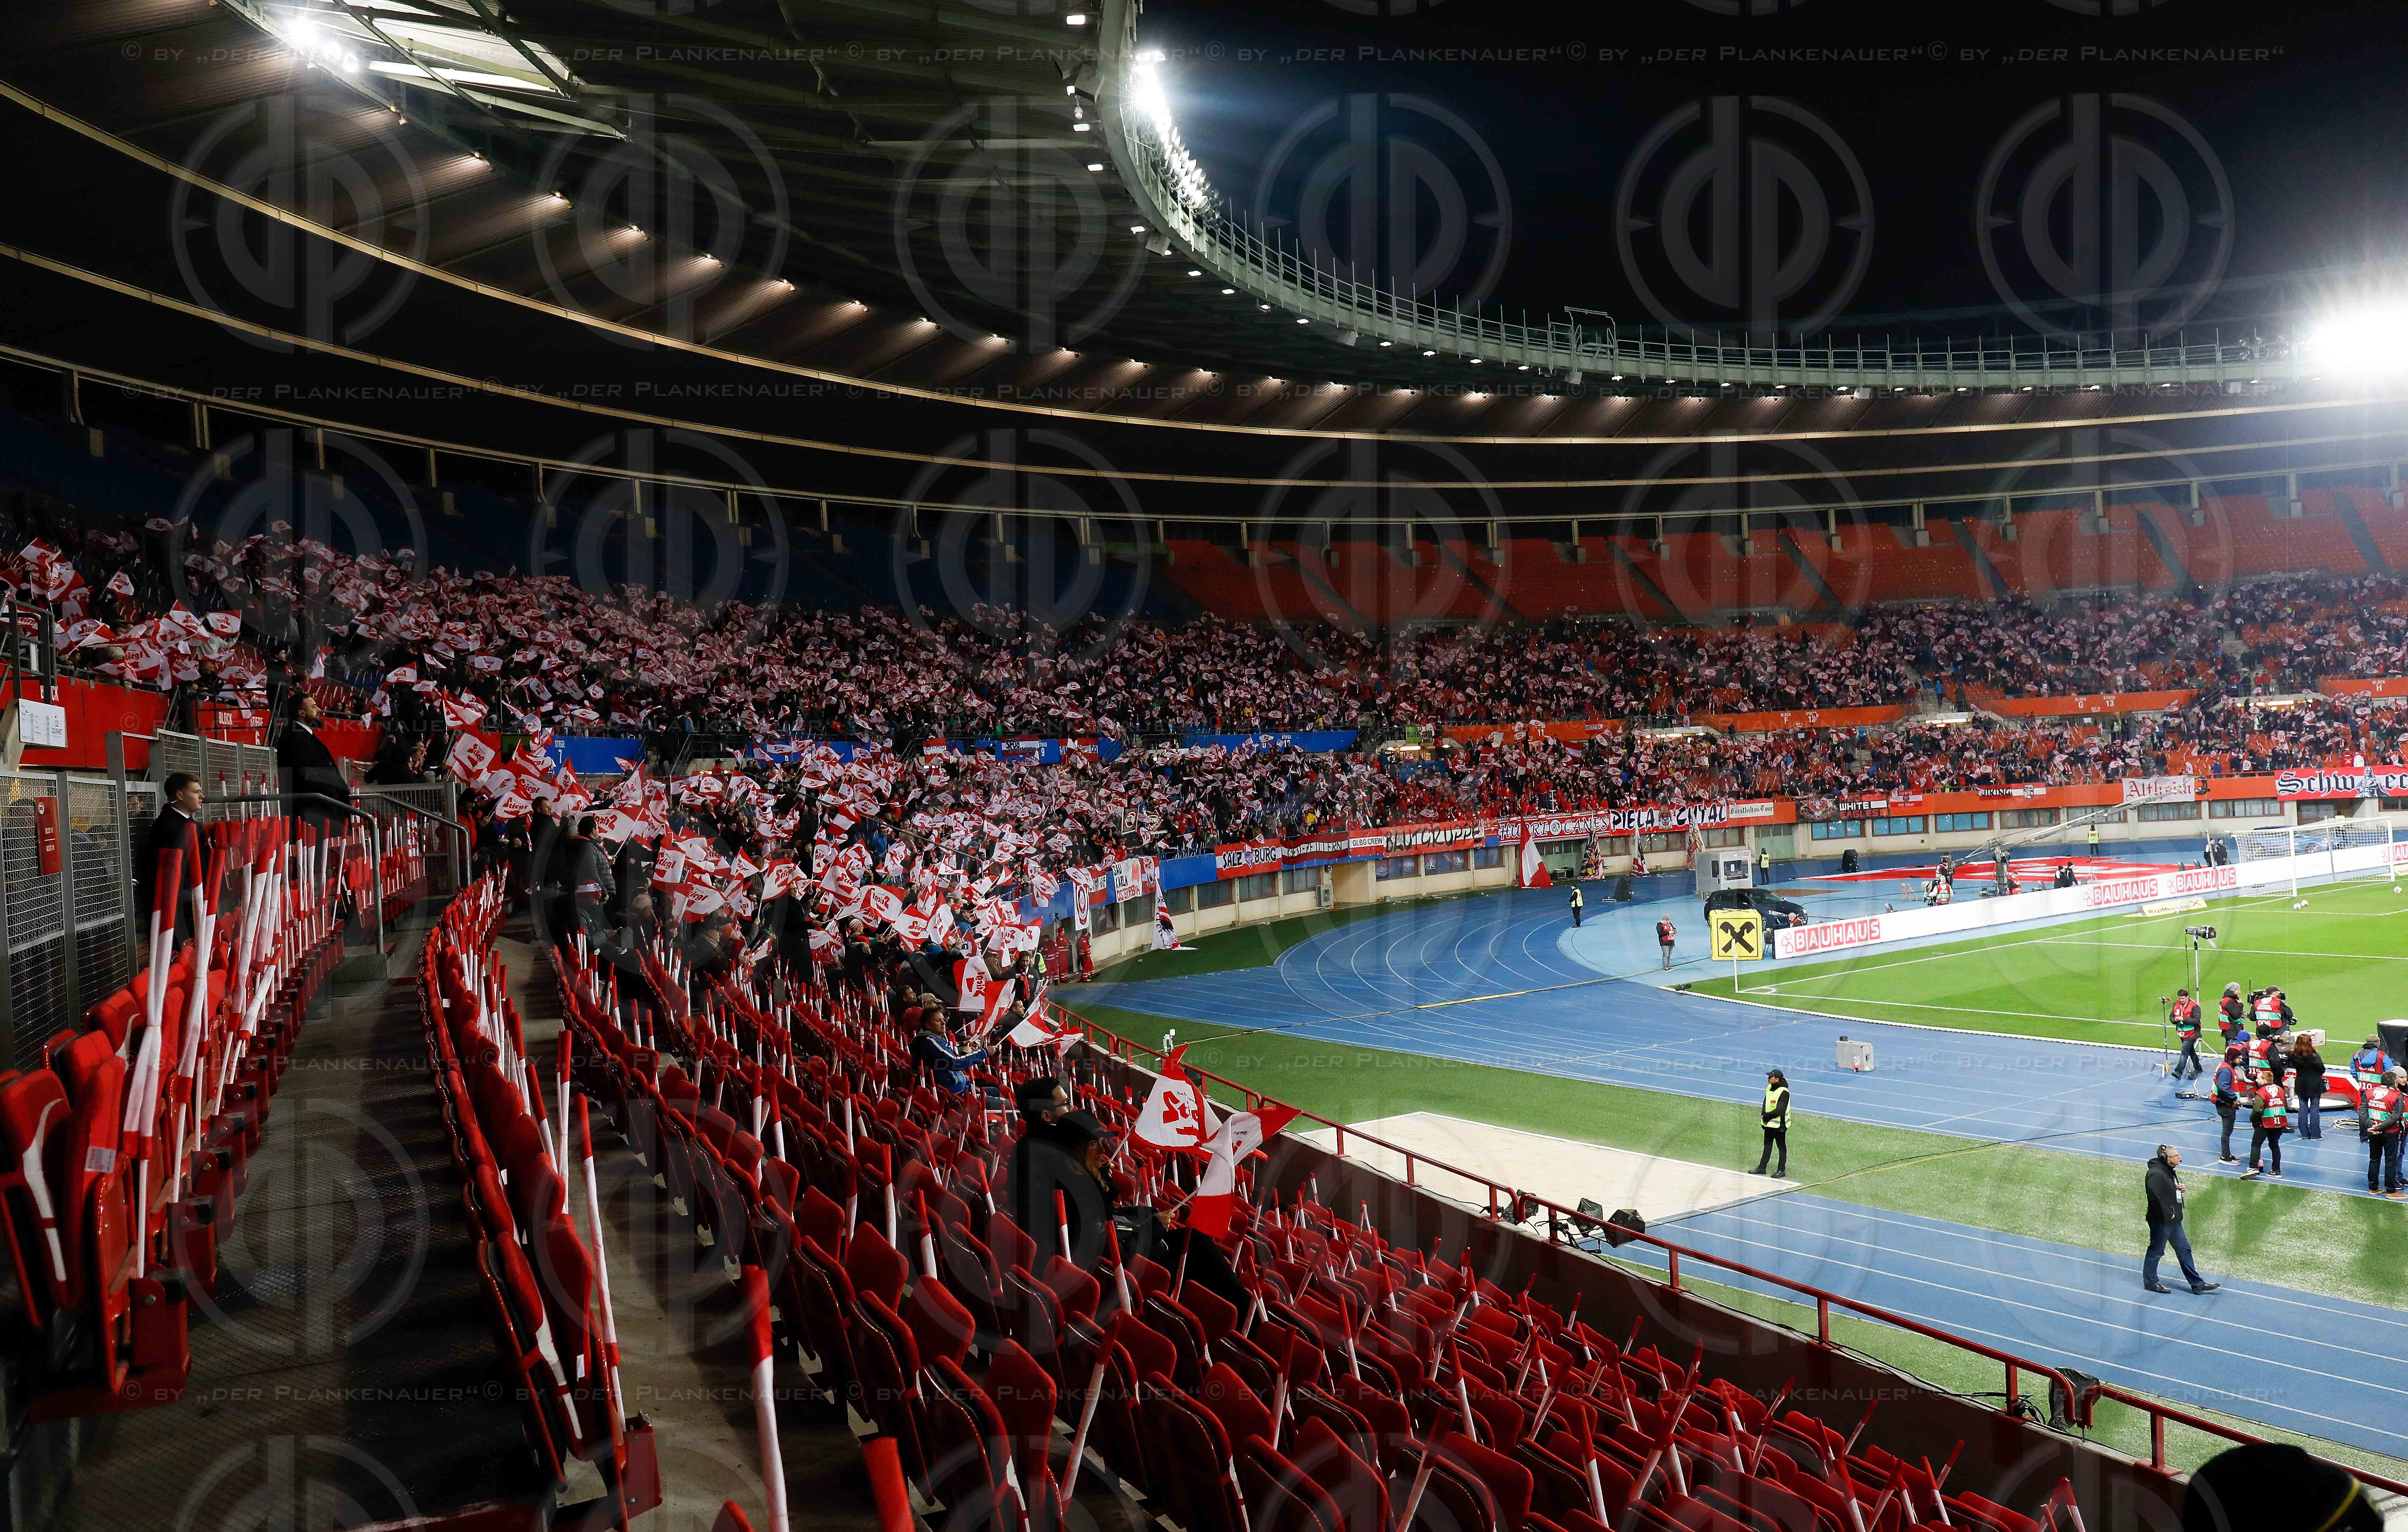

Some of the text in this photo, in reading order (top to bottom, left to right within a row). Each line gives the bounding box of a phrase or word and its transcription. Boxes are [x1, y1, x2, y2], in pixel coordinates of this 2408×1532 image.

[219, 712, 233, 725] BLOCK
[256, 731, 261, 745] 6
[559, 749, 562, 764] 7
[1041, 748, 1045, 757] 9
[503, 797, 528, 810] Stiegl
[1840, 802, 1869, 810] WHITE
[1611, 809, 1655, 830] PIELA
[1840, 810, 1879, 818] EAGLES
[1386, 824, 1482, 852] BLUTGRUPPE
[657, 852, 677, 869] Stiegl
[1223, 846, 1276, 869] SALZ BURG
[1112, 863, 1122, 876] SAU
[2177, 867, 2236, 893] BAUHAUS
[2094, 878, 2158, 905] BAUHAUS
[1795, 918, 1880, 952] BAUHAUS
